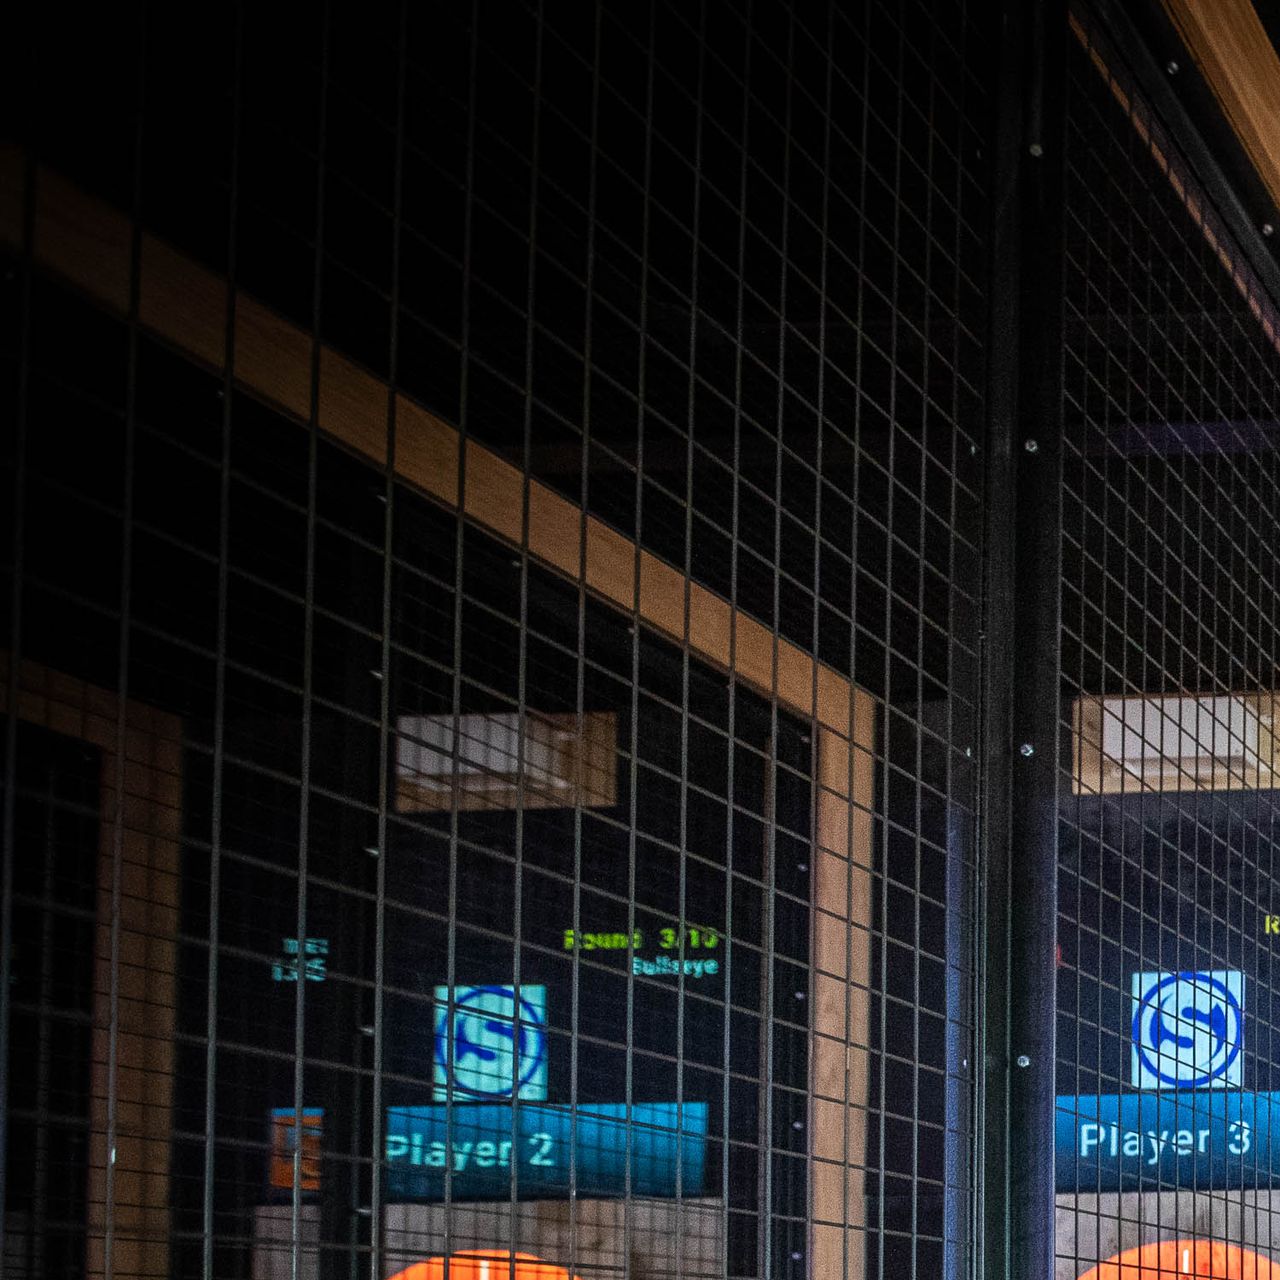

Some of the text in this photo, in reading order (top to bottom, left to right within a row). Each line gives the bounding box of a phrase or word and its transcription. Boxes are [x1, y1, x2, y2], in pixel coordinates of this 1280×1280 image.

[386, 1132, 554, 1173] Player 2
[1081, 1120, 1251, 1165] Player 3
